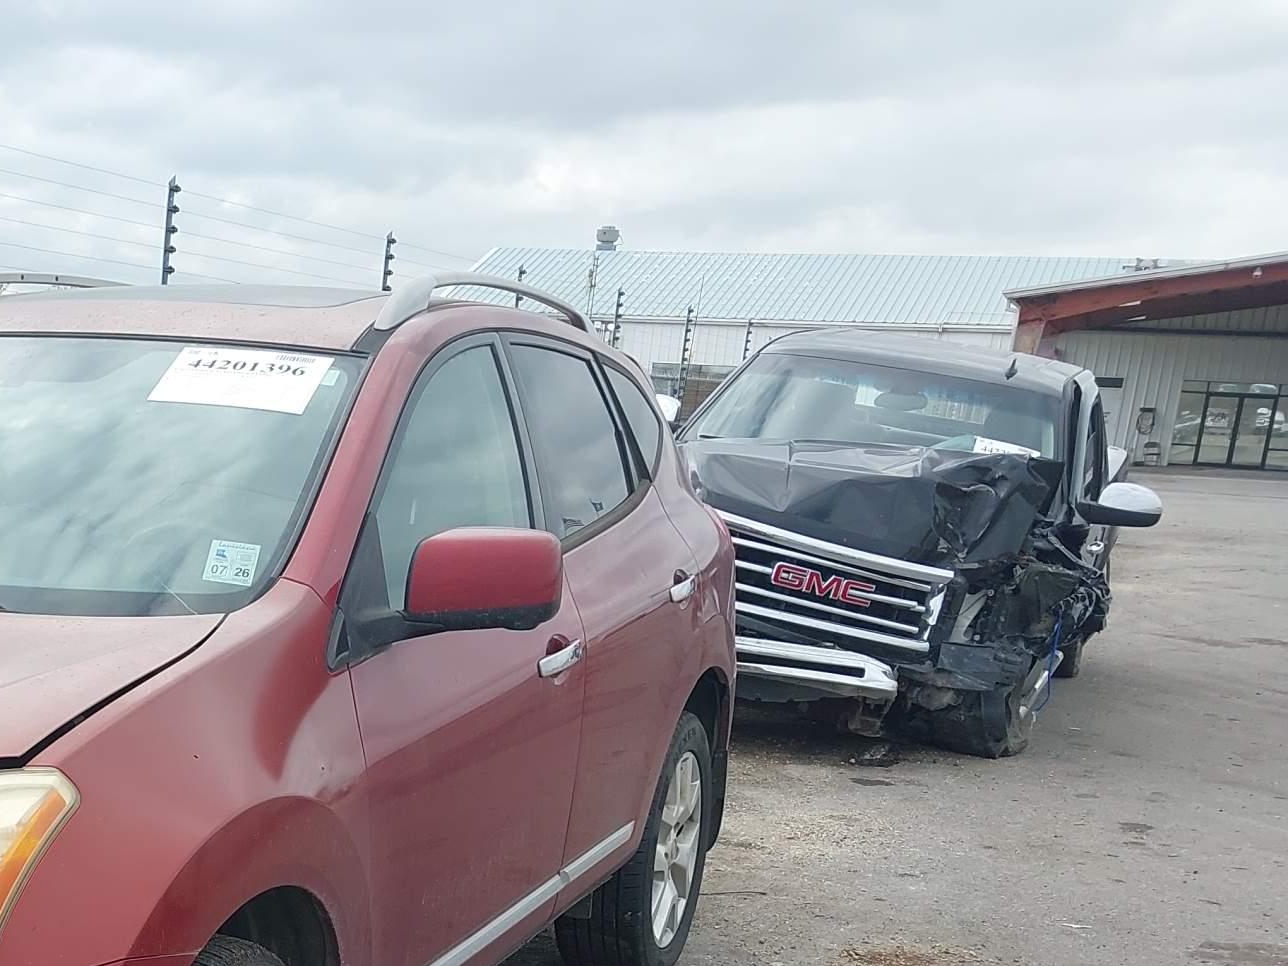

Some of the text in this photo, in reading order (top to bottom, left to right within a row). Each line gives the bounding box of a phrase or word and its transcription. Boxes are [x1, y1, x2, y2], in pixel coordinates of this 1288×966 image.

[188, 358, 306, 377] 44201396
[210, 564, 250, 578] 07 26
[770, 561, 876, 608] GMC
